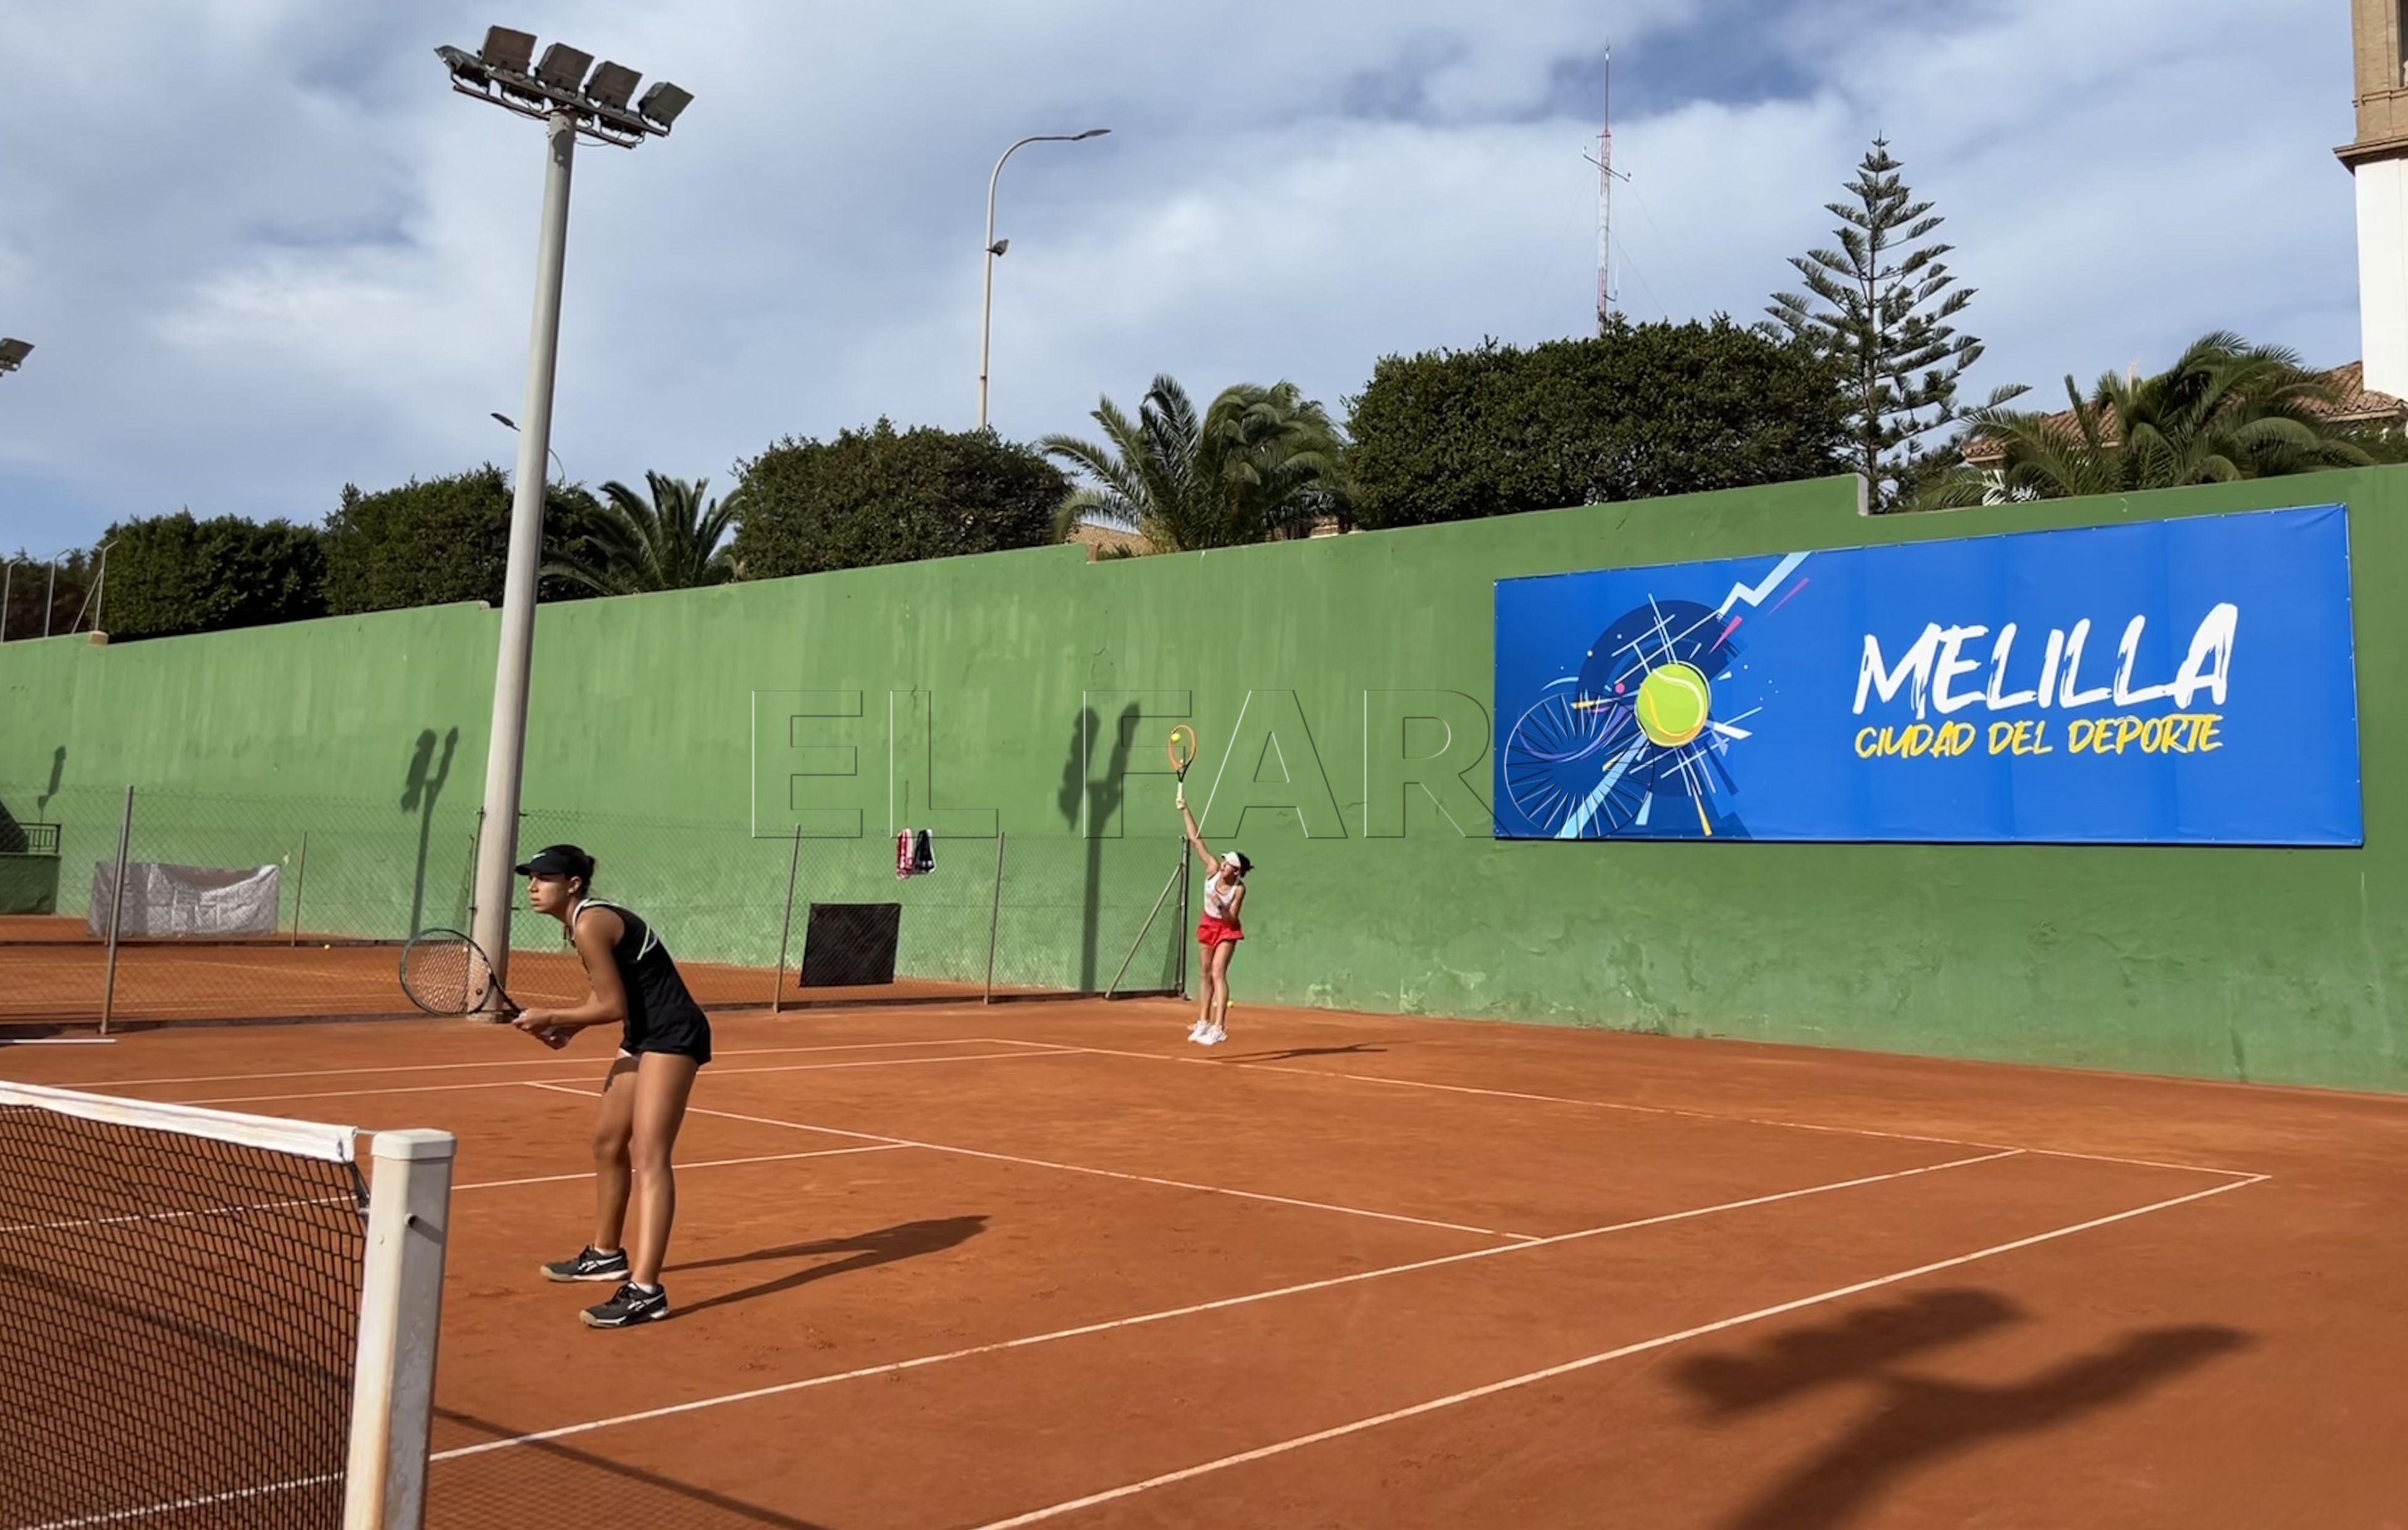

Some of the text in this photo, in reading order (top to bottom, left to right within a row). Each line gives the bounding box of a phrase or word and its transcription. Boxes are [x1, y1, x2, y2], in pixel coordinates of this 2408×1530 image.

[1853, 603, 2238, 720] MELILLA
[1855, 714, 2223, 759] CIUDAD DEL DEPORTE
